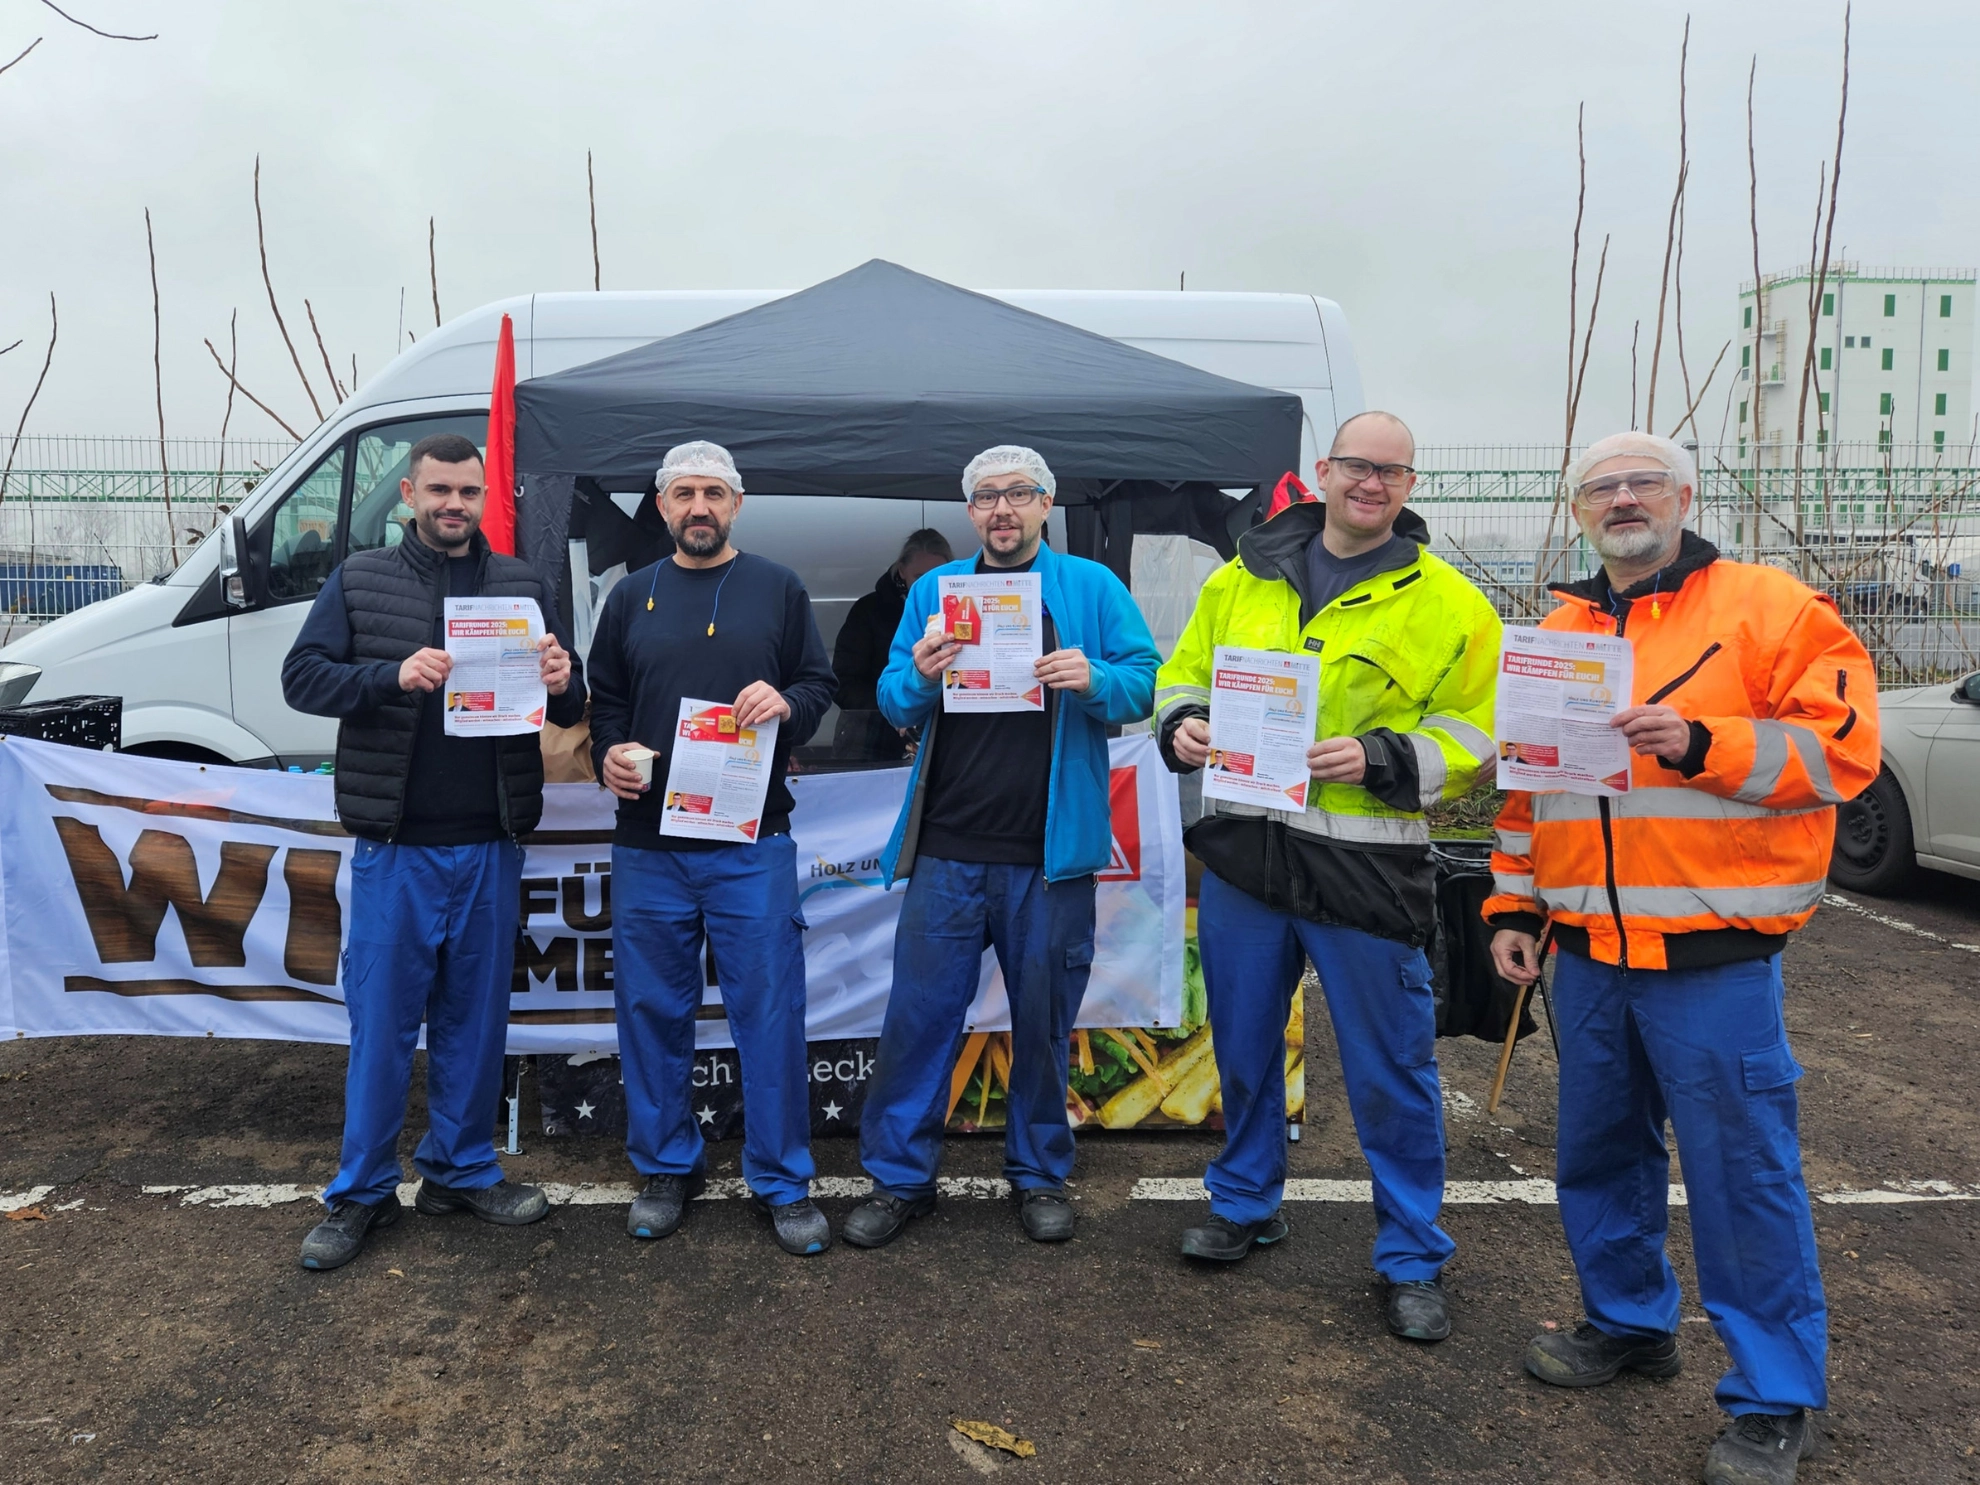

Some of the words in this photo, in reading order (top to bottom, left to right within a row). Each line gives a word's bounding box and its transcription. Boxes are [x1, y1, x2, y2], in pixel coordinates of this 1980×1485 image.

[1506, 663, 1521, 673] WIR
[1522, 664, 1559, 678] KÄMPFEN
[1559, 669, 1575, 680] FÜR
[1507, 655, 1553, 668] TARIFRUNDE
[1554, 661, 1576, 671] 2025:
[1218, 680, 1232, 688] WIR
[1232, 681, 1261, 691] KÄMPFEN
[1261, 684, 1275, 693] FÜR
[1219, 672, 1257, 683] TARIFRUNDE
[1258, 676, 1275, 685] 2025:
[811, 861, 856, 878] HOLZ
[860, 858, 881, 871] UN
[51, 815, 342, 986] WI
[519, 861, 613, 932] FÜ
